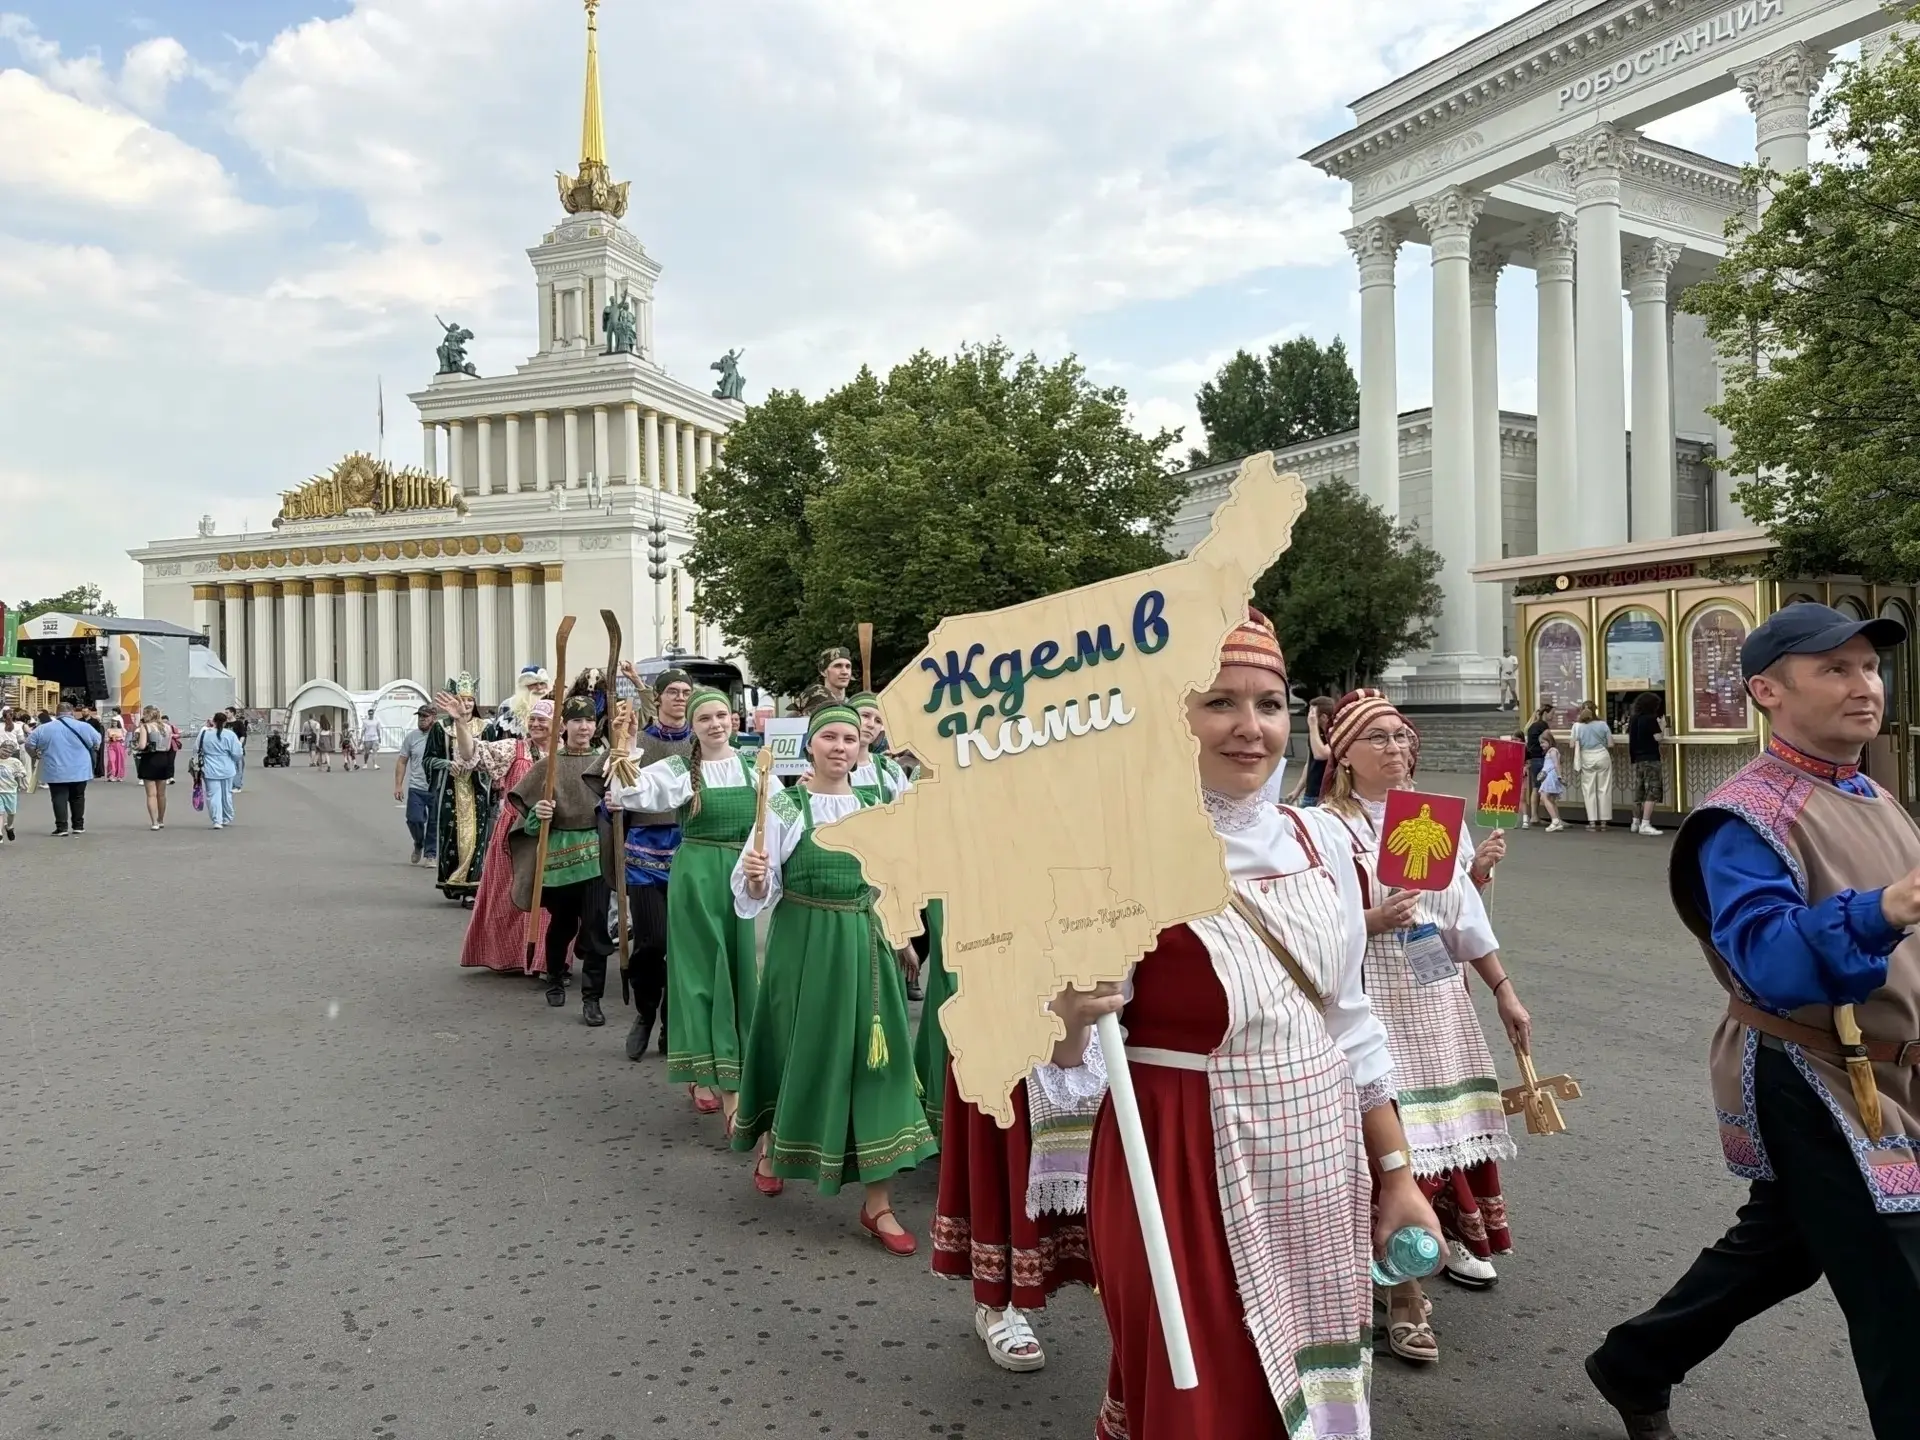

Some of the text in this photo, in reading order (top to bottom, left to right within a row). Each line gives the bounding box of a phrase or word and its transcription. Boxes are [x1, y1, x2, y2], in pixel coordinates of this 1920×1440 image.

[1557, 0, 1784, 110] РОБОСТАНЦИЯ
[921, 590, 1170, 717] Ждем в
[771, 738, 797, 756] ГОД
[937, 687, 1136, 768] Коми
